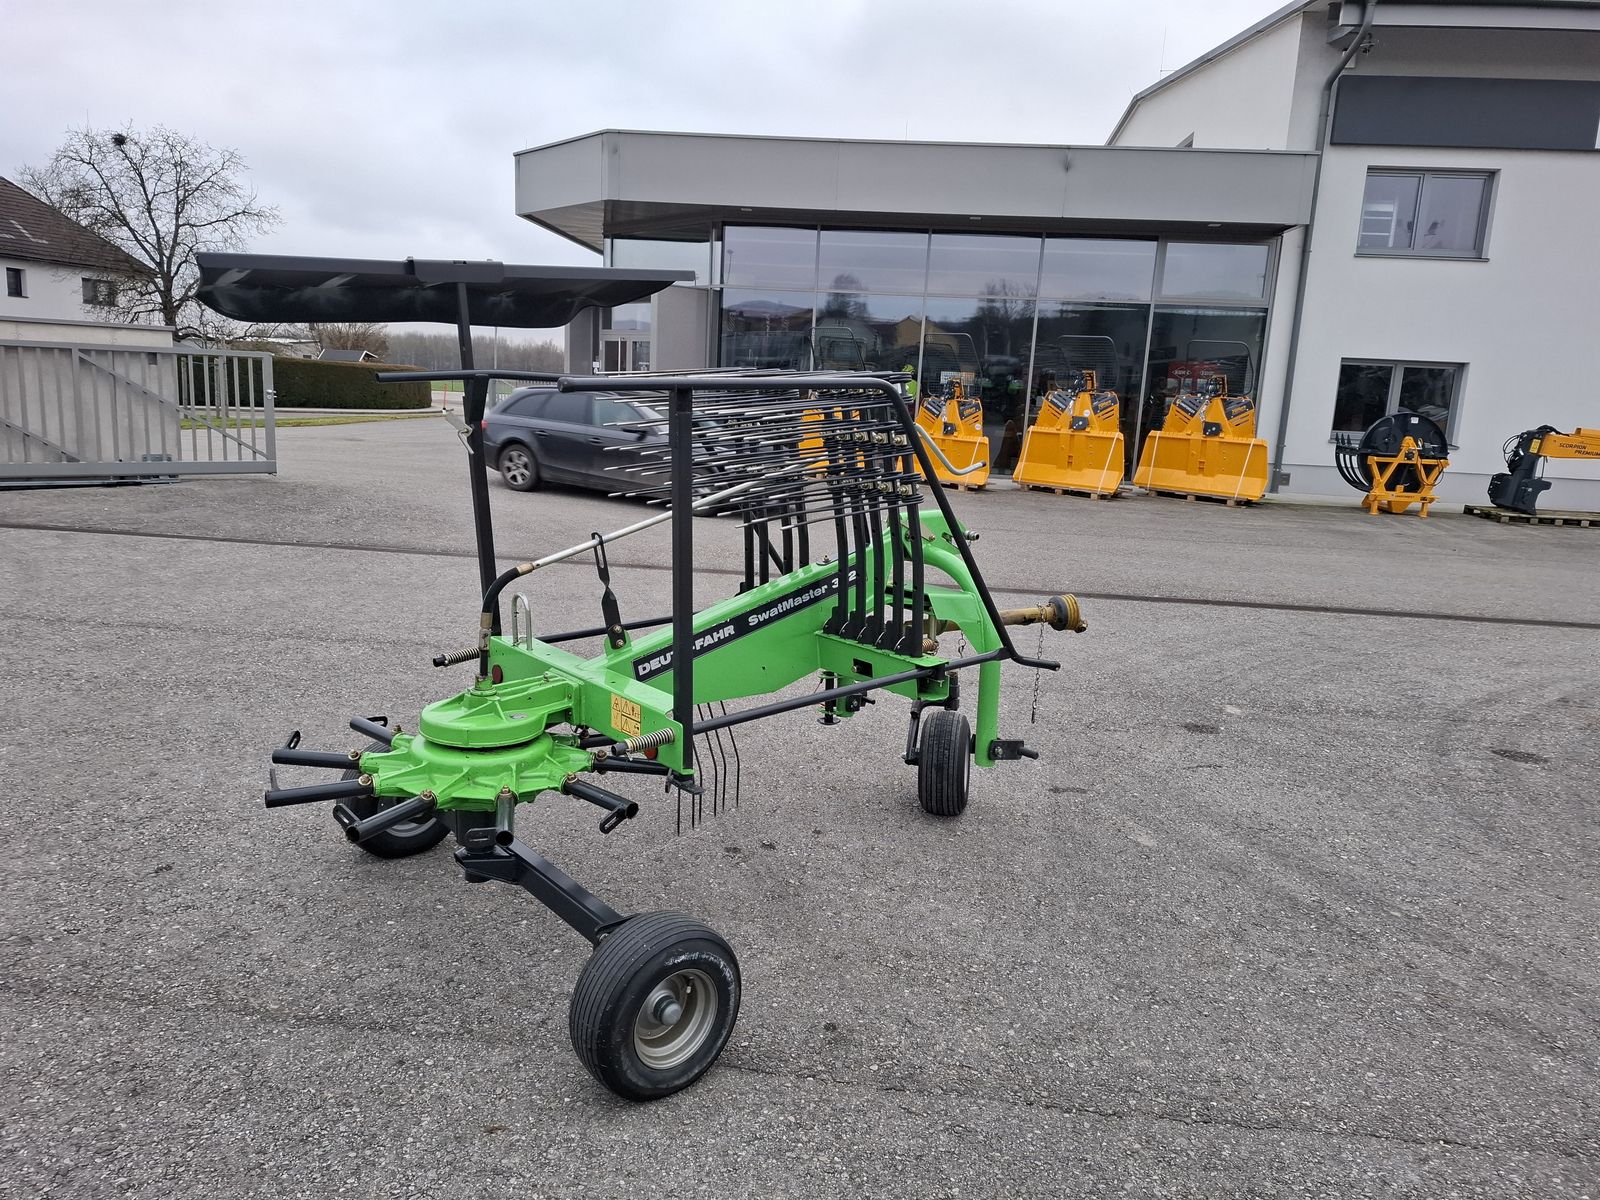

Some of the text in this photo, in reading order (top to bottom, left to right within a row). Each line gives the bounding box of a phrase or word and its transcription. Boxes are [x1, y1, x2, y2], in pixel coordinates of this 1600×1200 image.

[637, 570, 857, 676] DEU-FAHR SwatMaster 32
